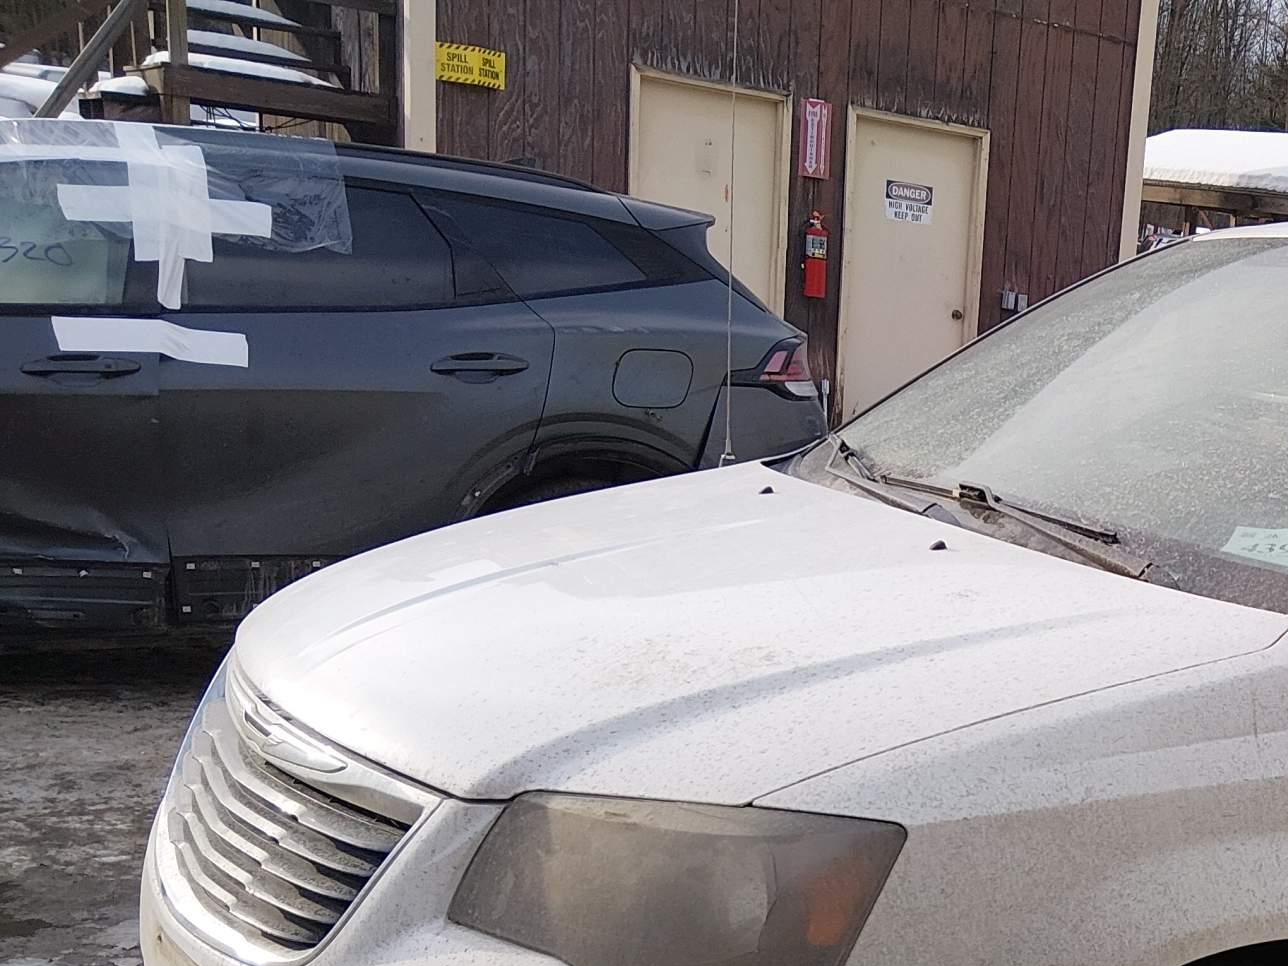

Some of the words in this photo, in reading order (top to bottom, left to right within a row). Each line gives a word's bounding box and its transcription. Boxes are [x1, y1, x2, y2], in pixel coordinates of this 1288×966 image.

[446, 52, 468, 63] SPILL
[481, 57, 496, 69] SPILL
[440, 63, 474, 75] STATION
[479, 67, 499, 80] STATION
[892, 186, 927, 200] DANGER
[888, 200, 903, 210] HIGH
[905, 203, 929, 215] VOLTAGE
[894, 211, 908, 221] KEEP
[911, 213, 923, 222] OUT
